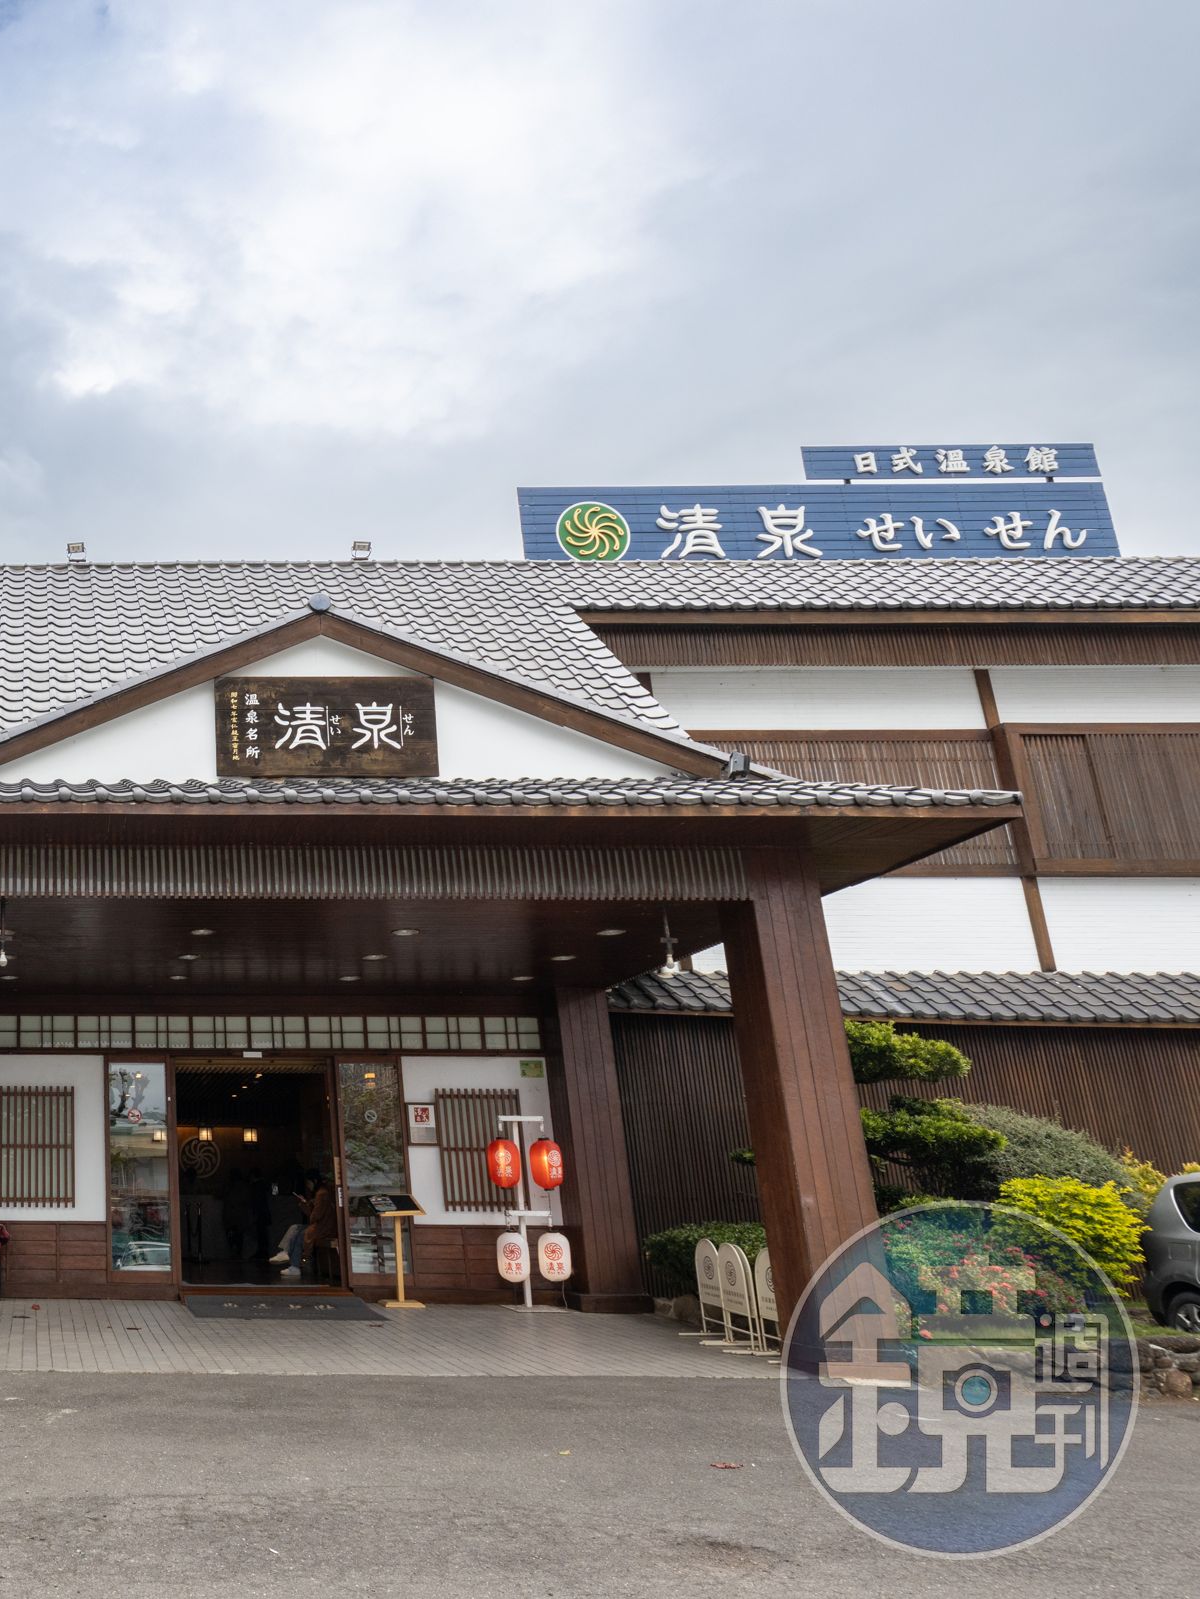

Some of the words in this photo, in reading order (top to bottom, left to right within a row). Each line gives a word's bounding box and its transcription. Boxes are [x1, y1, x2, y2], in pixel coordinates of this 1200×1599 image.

[853, 445, 1059, 475] 日式溫泉館
[656, 503, 823, 559] 清泉
[244, 693, 260, 759] 溫泉名所
[274, 701, 402, 750] 清泉
[329, 714, 342, 736] せい
[402, 713, 415, 736] せん
